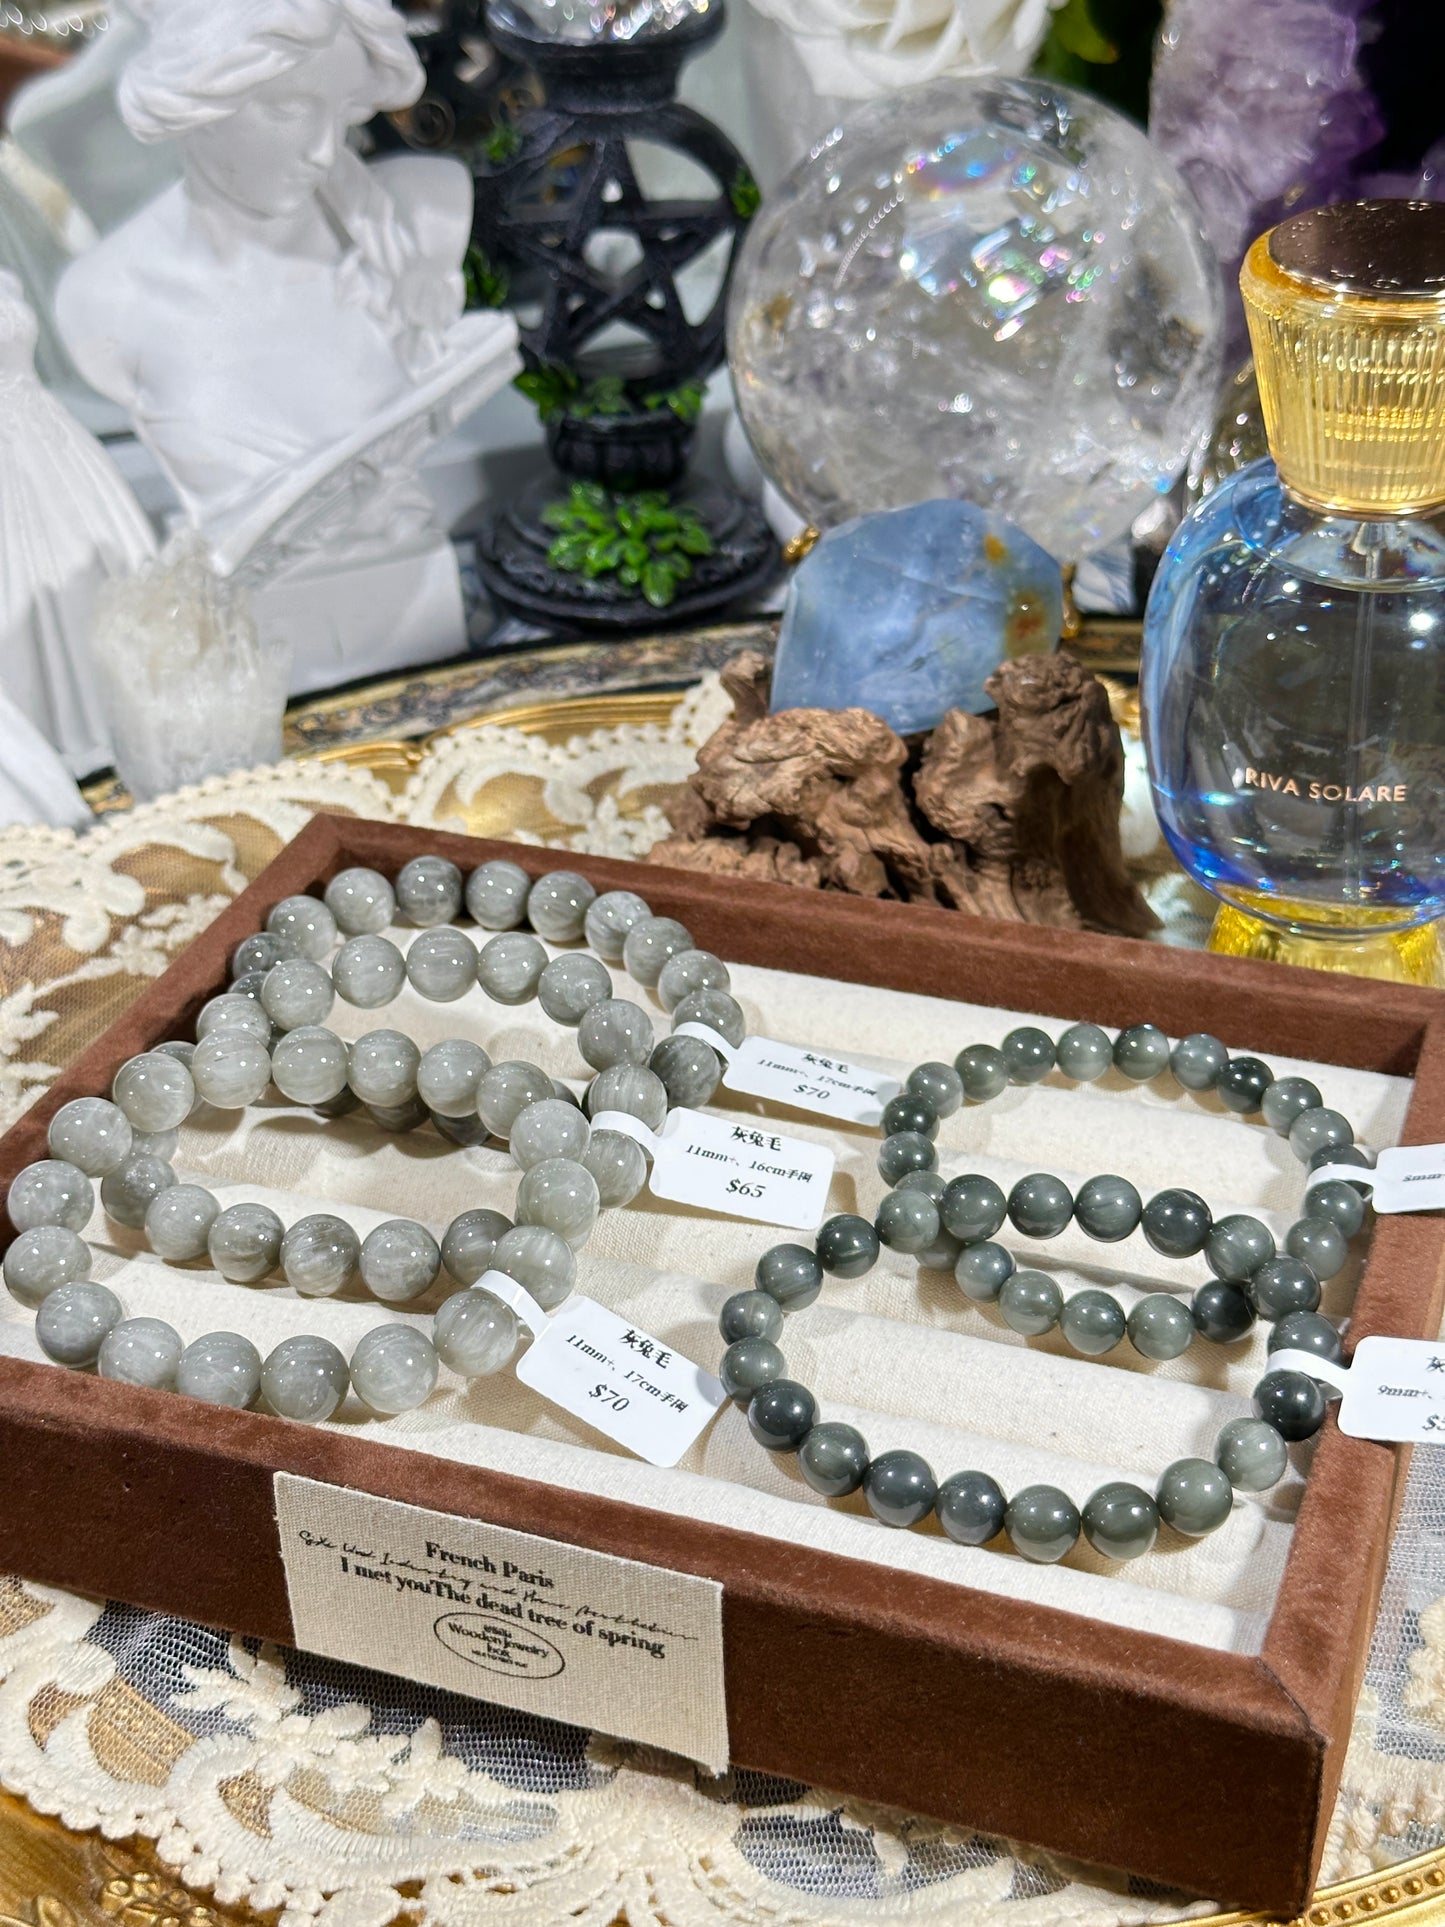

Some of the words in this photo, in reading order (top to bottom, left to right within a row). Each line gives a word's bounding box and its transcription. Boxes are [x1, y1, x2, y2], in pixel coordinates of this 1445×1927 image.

[1244, 767, 1301, 797] RIVA
[1308, 782, 1409, 802] SOLARE
[793, 1083, 831, 1101] $70
[730, 1126, 783, 1152] 灰兔毛
[725, 1177, 767, 1199] $65
[619, 1328, 673, 1370] 灰兔毛
[588, 1383, 631, 1413] $70
[424, 1540, 497, 1575] French
[502, 1560, 555, 1590] Paris
[340, 1555, 349, 1573] I
[354, 1564, 394, 1585] met
[475, 1591, 524, 1620] dead
[527, 1608, 569, 1631] tree
[572, 1619, 595, 1637] of
[598, 1627, 666, 1660] spring
